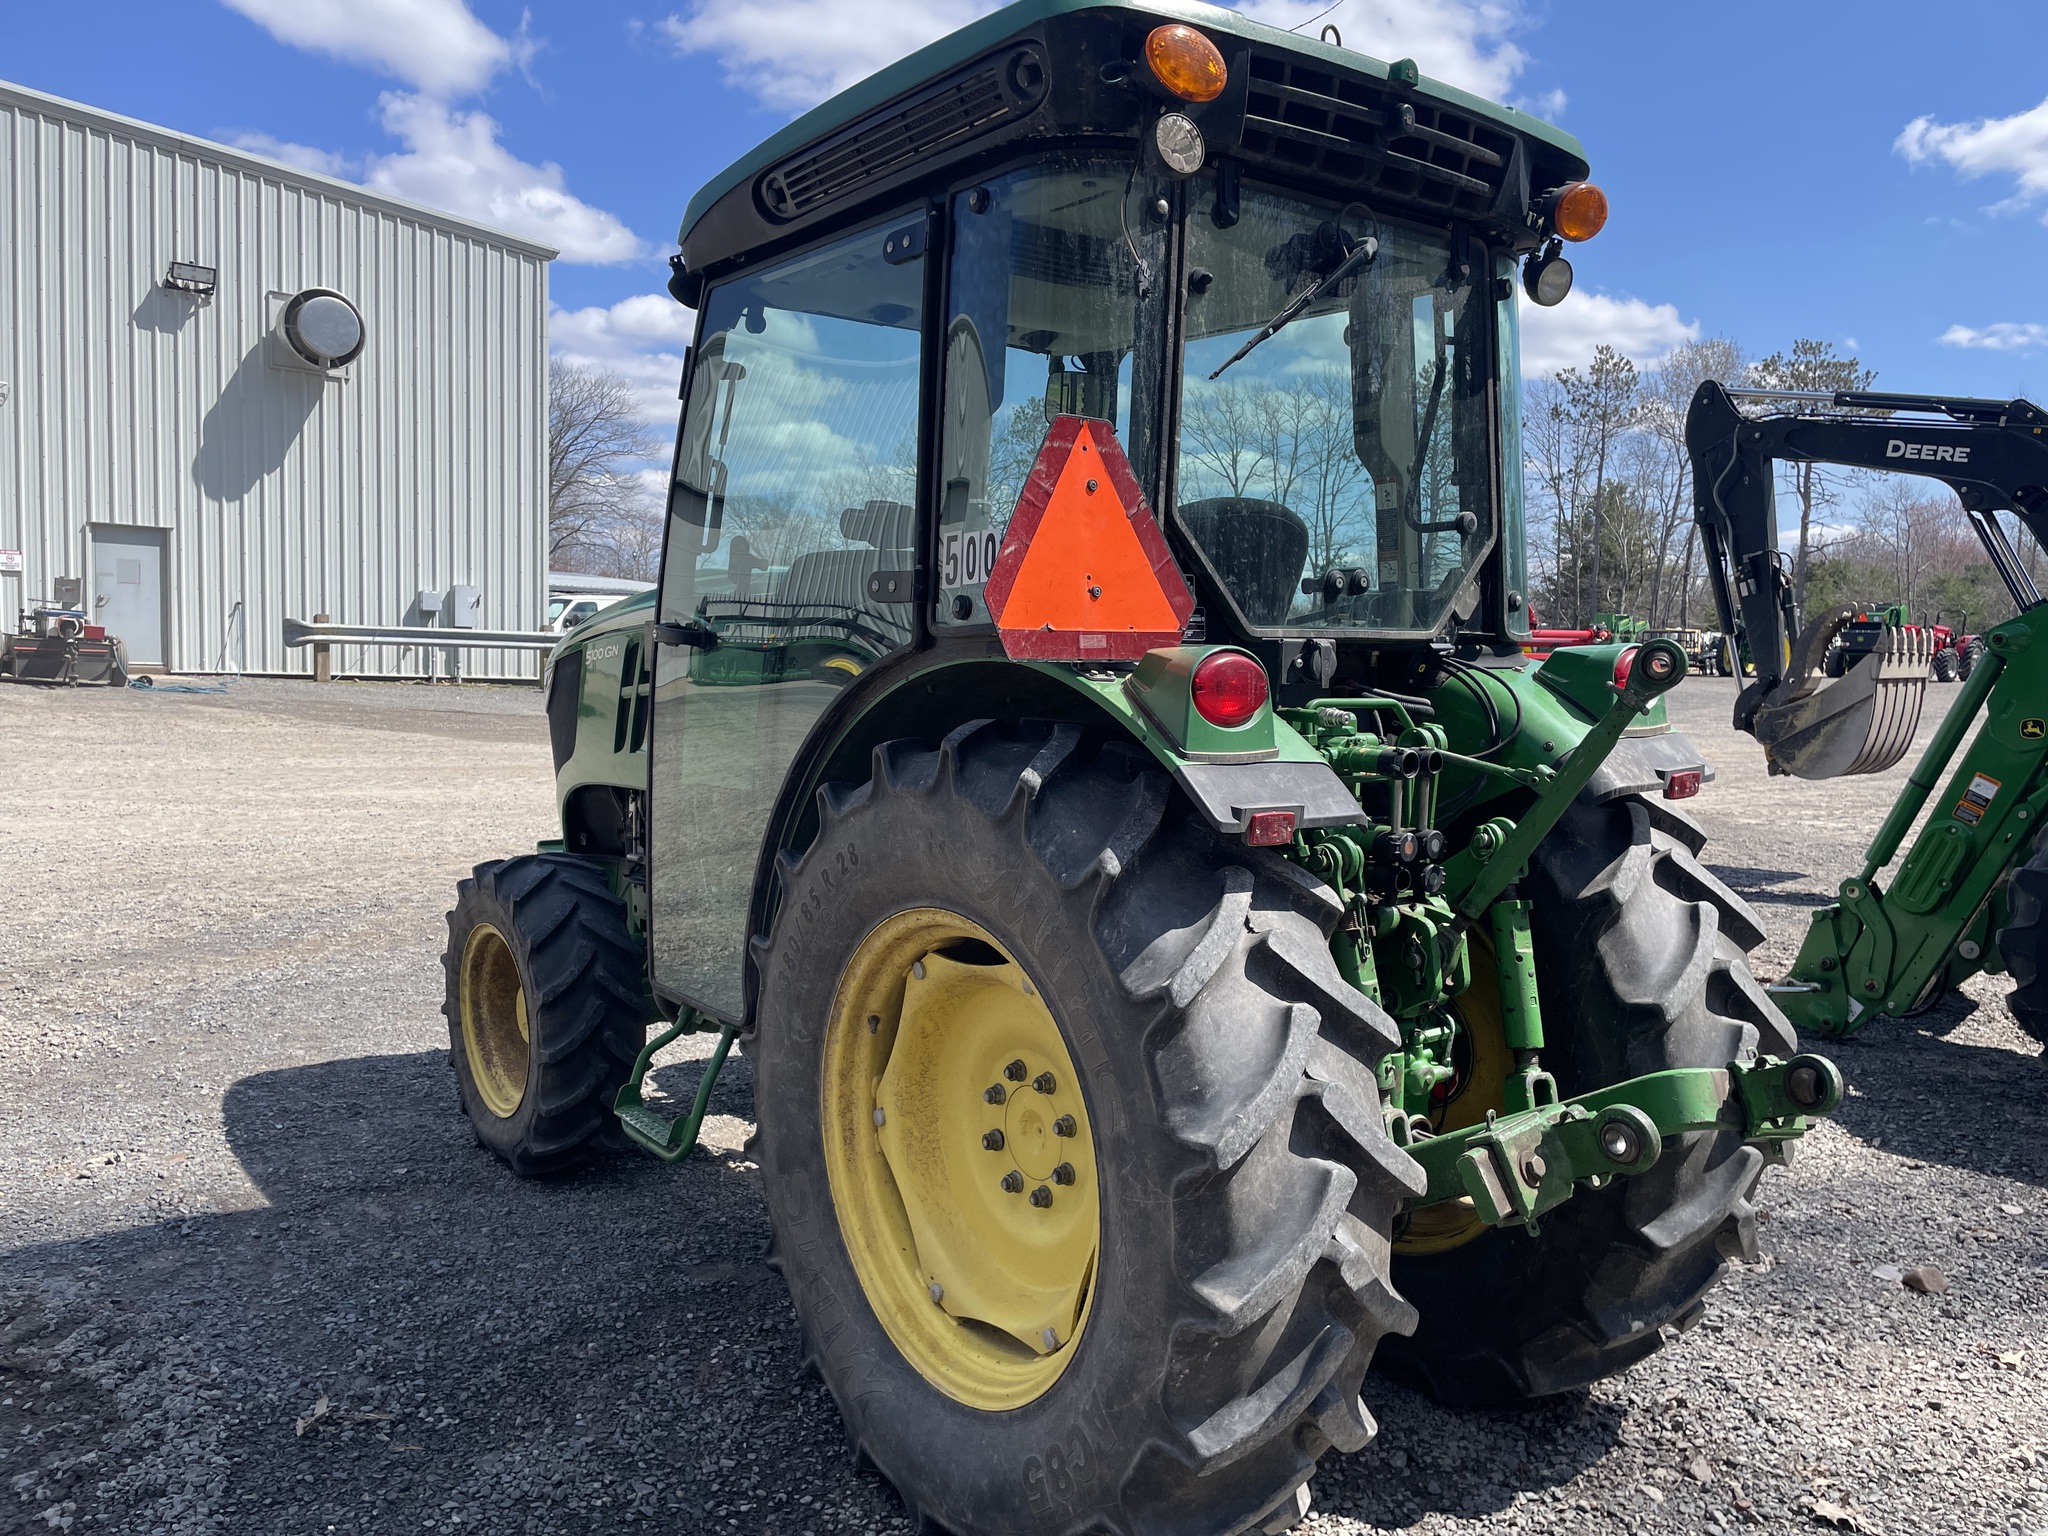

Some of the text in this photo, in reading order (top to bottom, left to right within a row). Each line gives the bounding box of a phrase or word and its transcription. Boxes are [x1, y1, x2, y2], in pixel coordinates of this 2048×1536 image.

[1886, 439, 1971, 463] DEERE
[604, 644, 620, 658] GN
[778, 842, 859, 991] 380/85 R 28
